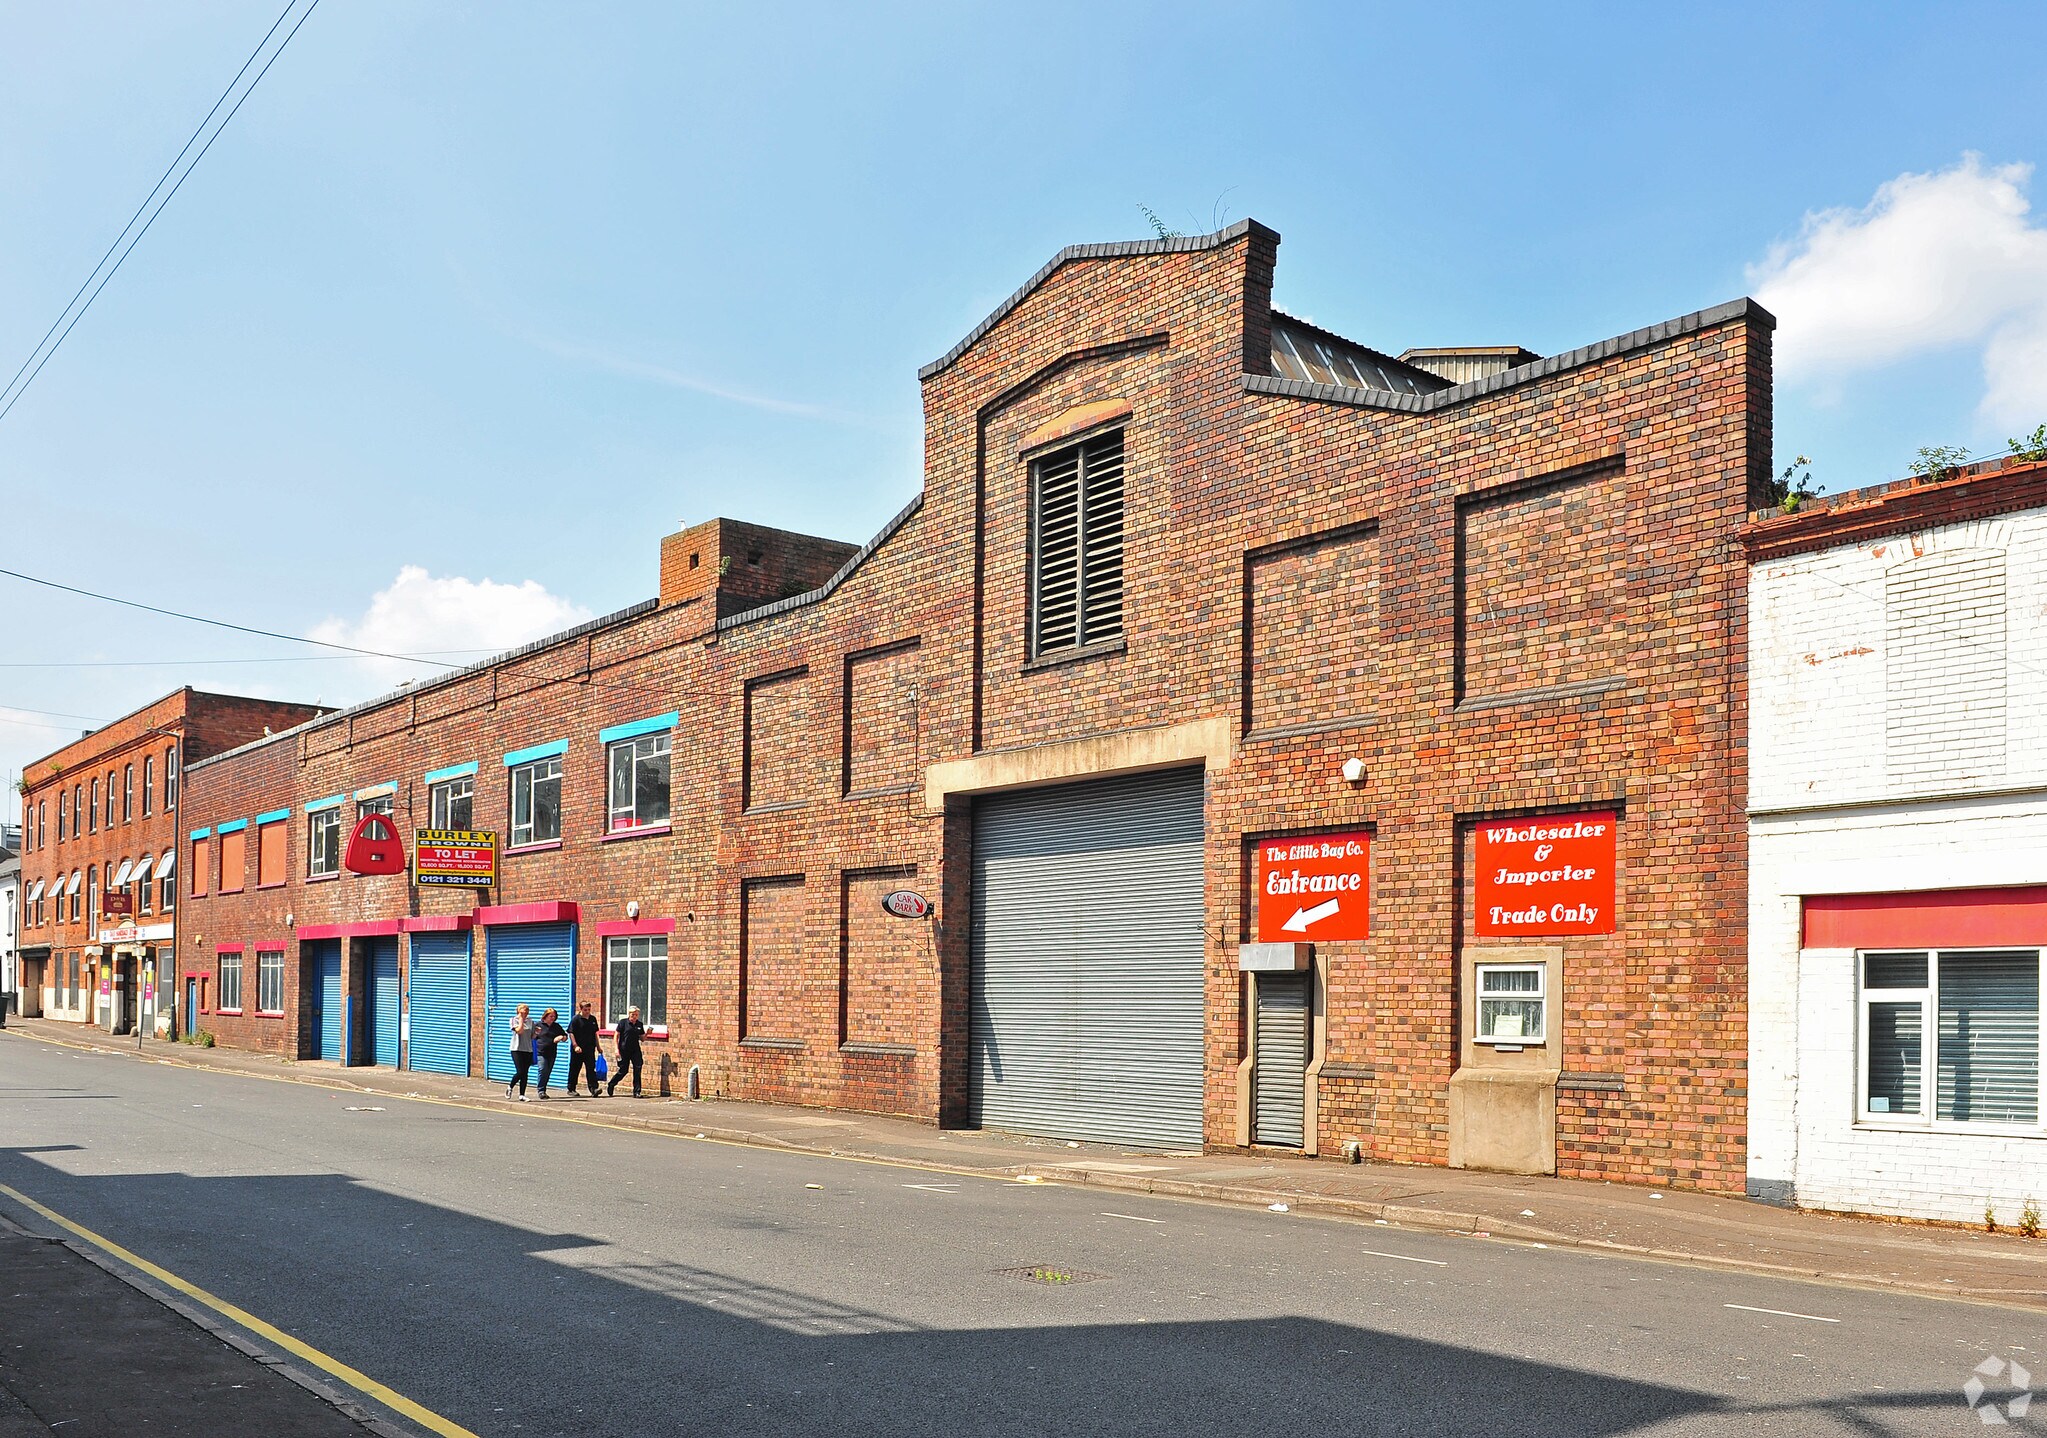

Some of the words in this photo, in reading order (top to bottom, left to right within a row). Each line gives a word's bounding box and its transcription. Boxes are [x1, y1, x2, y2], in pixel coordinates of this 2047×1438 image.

[418, 831, 492, 840] BURLEY
[1486, 822, 1606, 844] Wholesaler
[434, 849, 451, 858] TO
[455, 850, 477, 858] LET
[1266, 847, 1287, 862] The
[1289, 844, 1319, 861] Little
[1321, 842, 1345, 860] Bag
[1346, 840, 1364, 857] Co.
[1533, 844, 1553, 862] &
[1266, 869, 1361, 895] Entrance
[894, 902, 913, 912] PARK
[896, 894, 912, 903] CAR
[1489, 905, 1547, 925] Trade
[1550, 903, 1599, 925] Only
